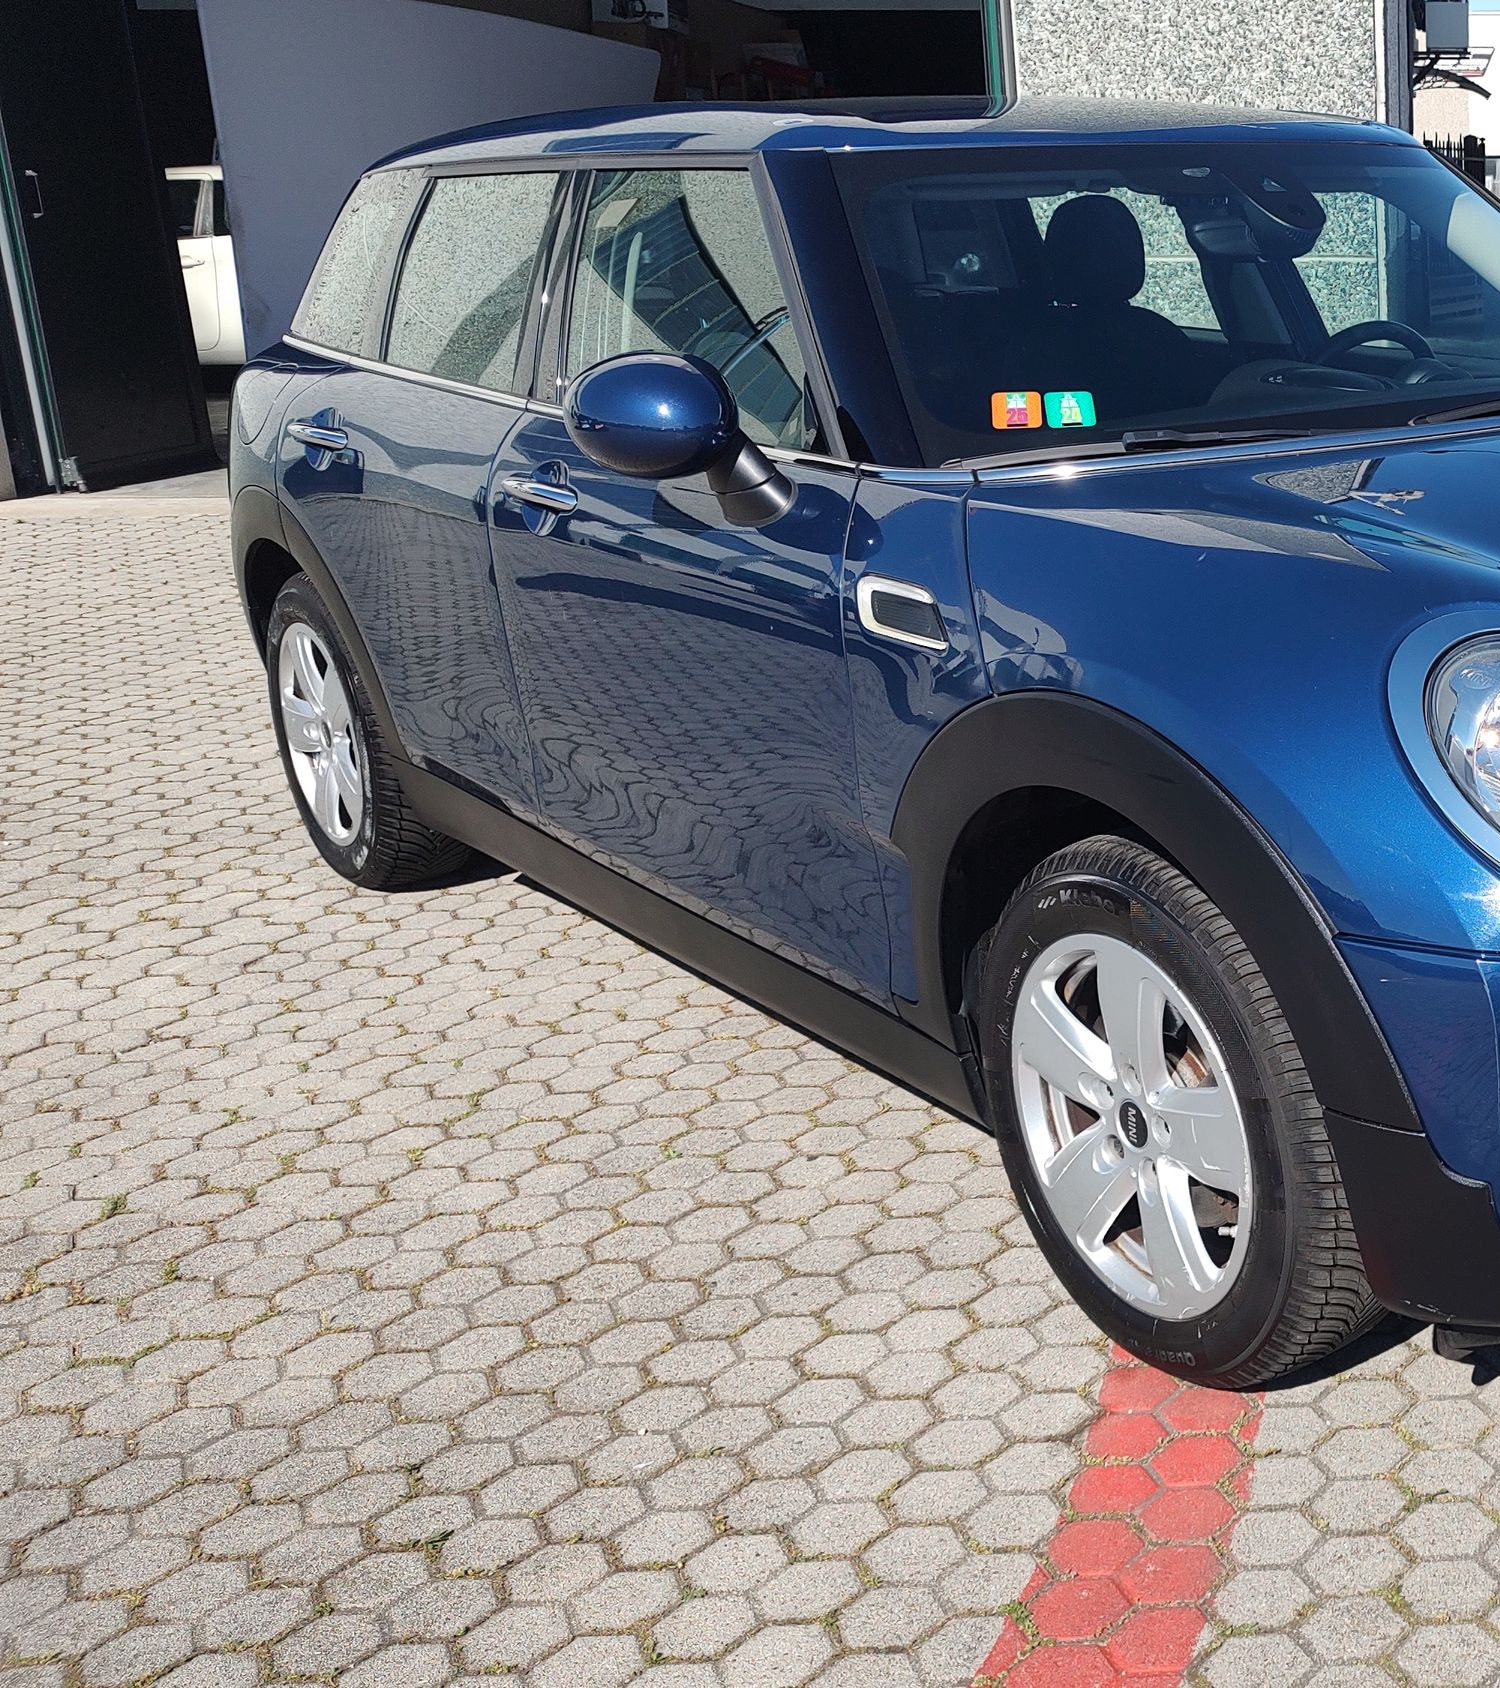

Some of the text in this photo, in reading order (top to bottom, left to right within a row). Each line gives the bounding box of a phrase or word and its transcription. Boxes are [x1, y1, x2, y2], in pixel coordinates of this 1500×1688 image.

[1006, 408, 1028, 423] 25
[1059, 888, 1126, 920] Klebe
[1127, 1106, 1138, 1144] MINI
